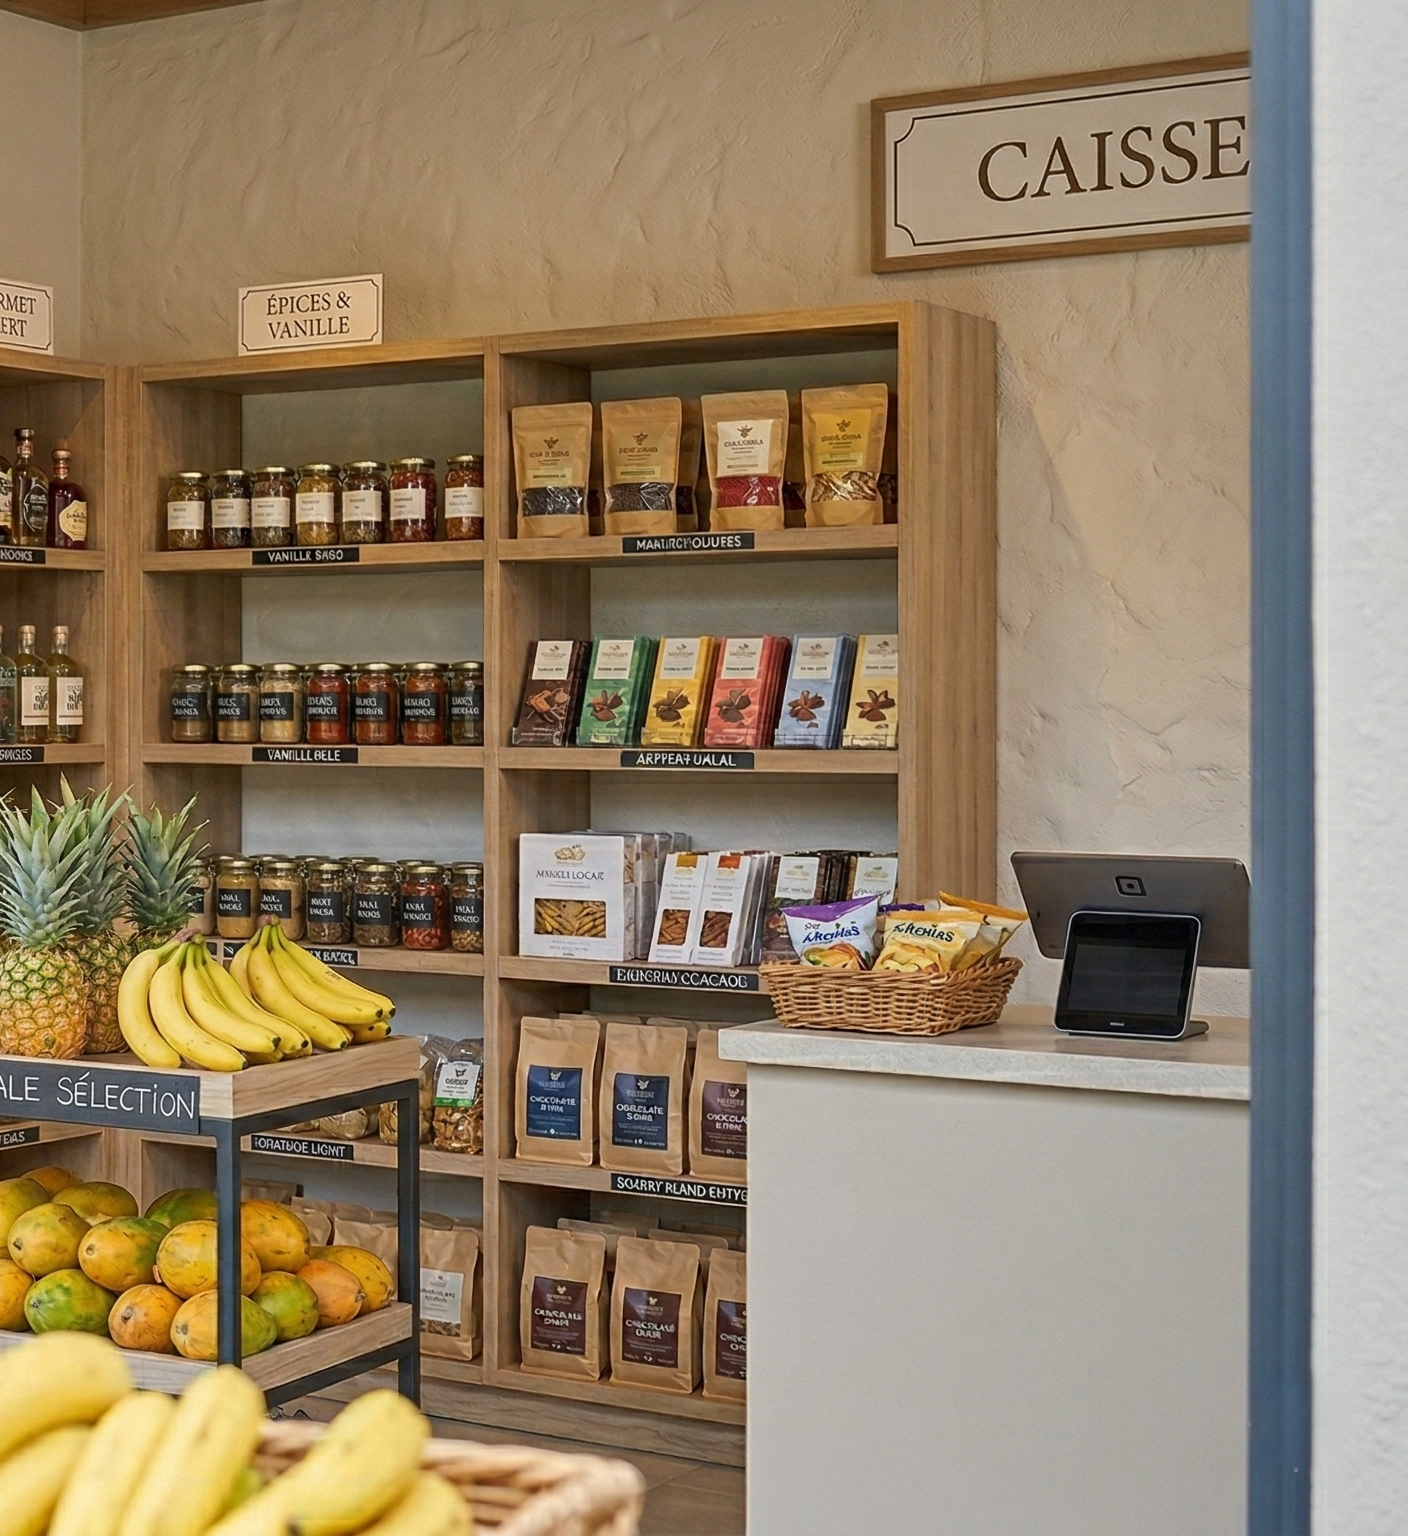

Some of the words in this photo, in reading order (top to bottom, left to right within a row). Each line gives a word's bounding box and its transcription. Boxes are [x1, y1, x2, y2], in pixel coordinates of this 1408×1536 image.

[978, 115, 1251, 202] CAISSE
[266, 292, 331, 316] ÉPICES
[336, 291, 352, 309] &
[267, 316, 350, 340] VANILLE
